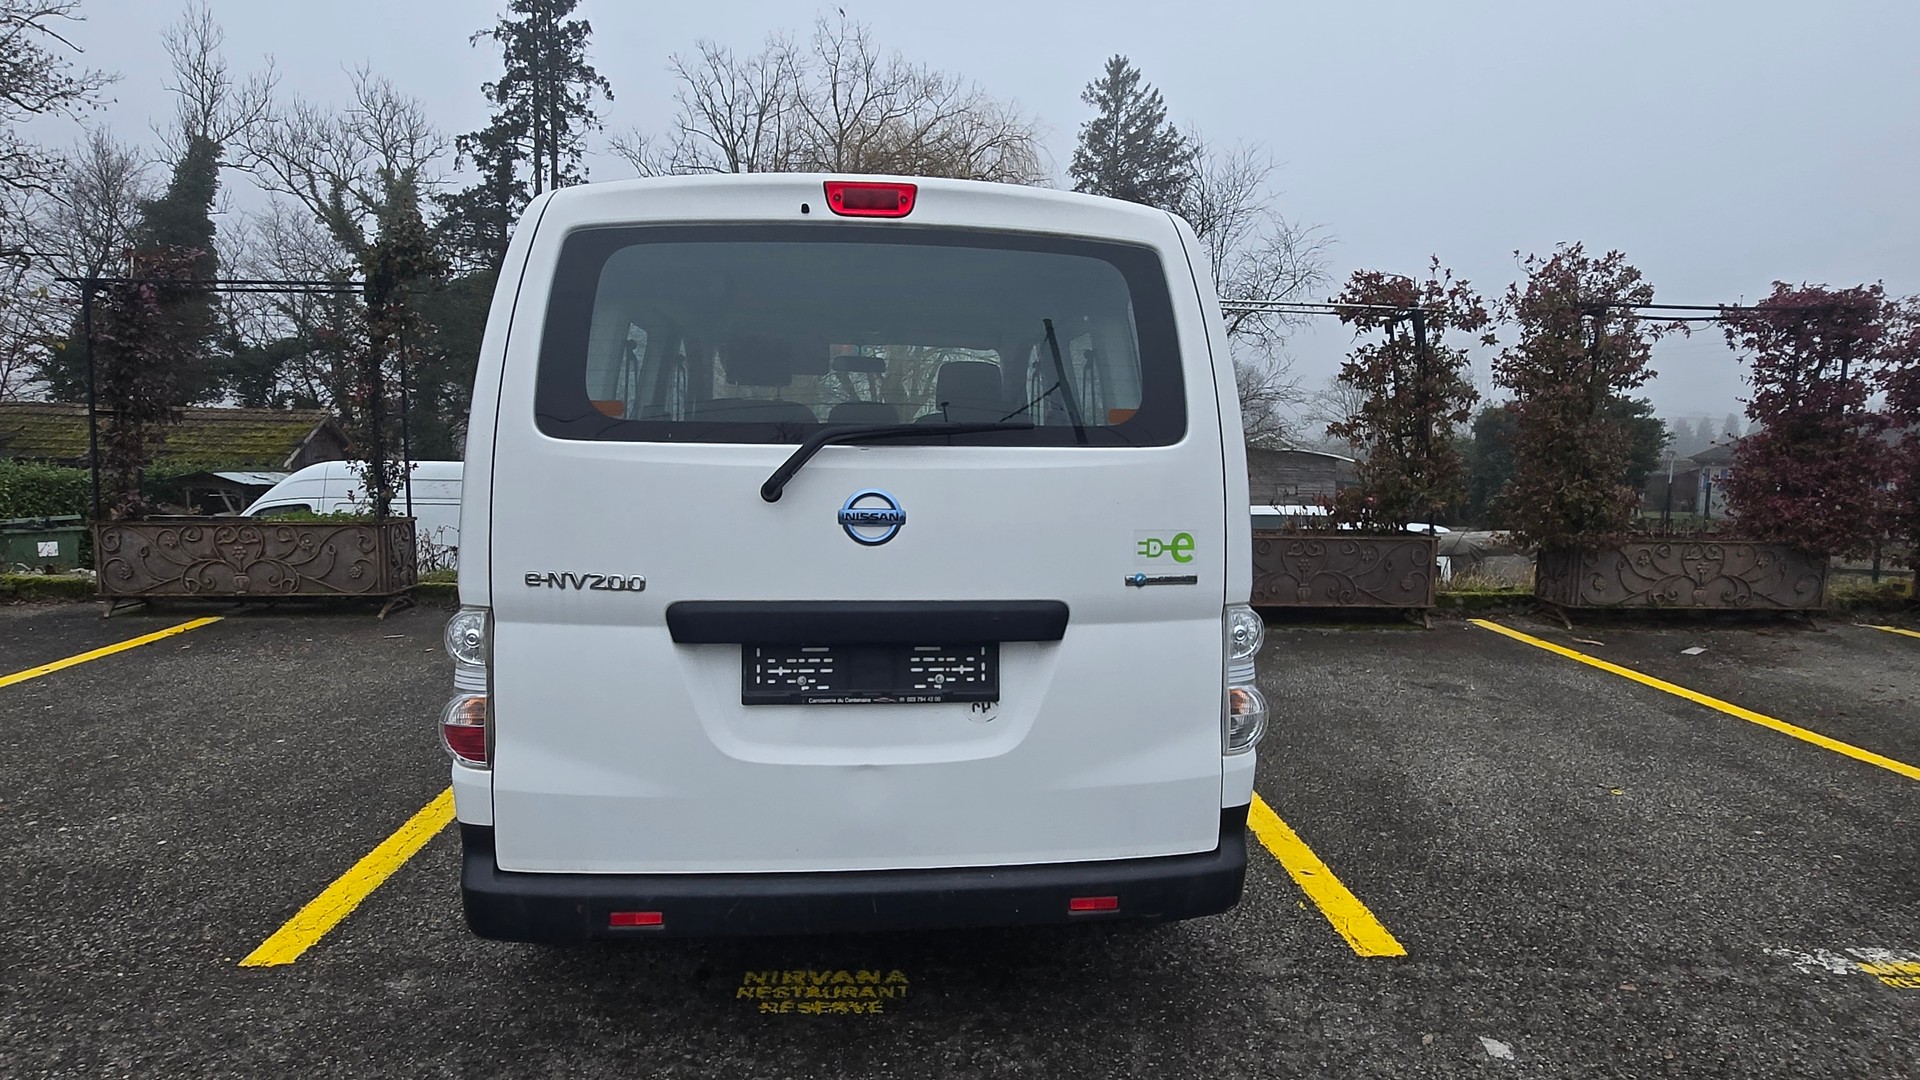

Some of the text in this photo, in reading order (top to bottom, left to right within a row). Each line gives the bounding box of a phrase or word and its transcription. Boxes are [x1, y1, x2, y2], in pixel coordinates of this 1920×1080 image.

[845, 512, 899, 521] NISSAN
[525, 571, 646, 591] e-NV200
[743, 969, 909, 985] NIRVANA
[736, 985, 908, 999] RESTAURANT
